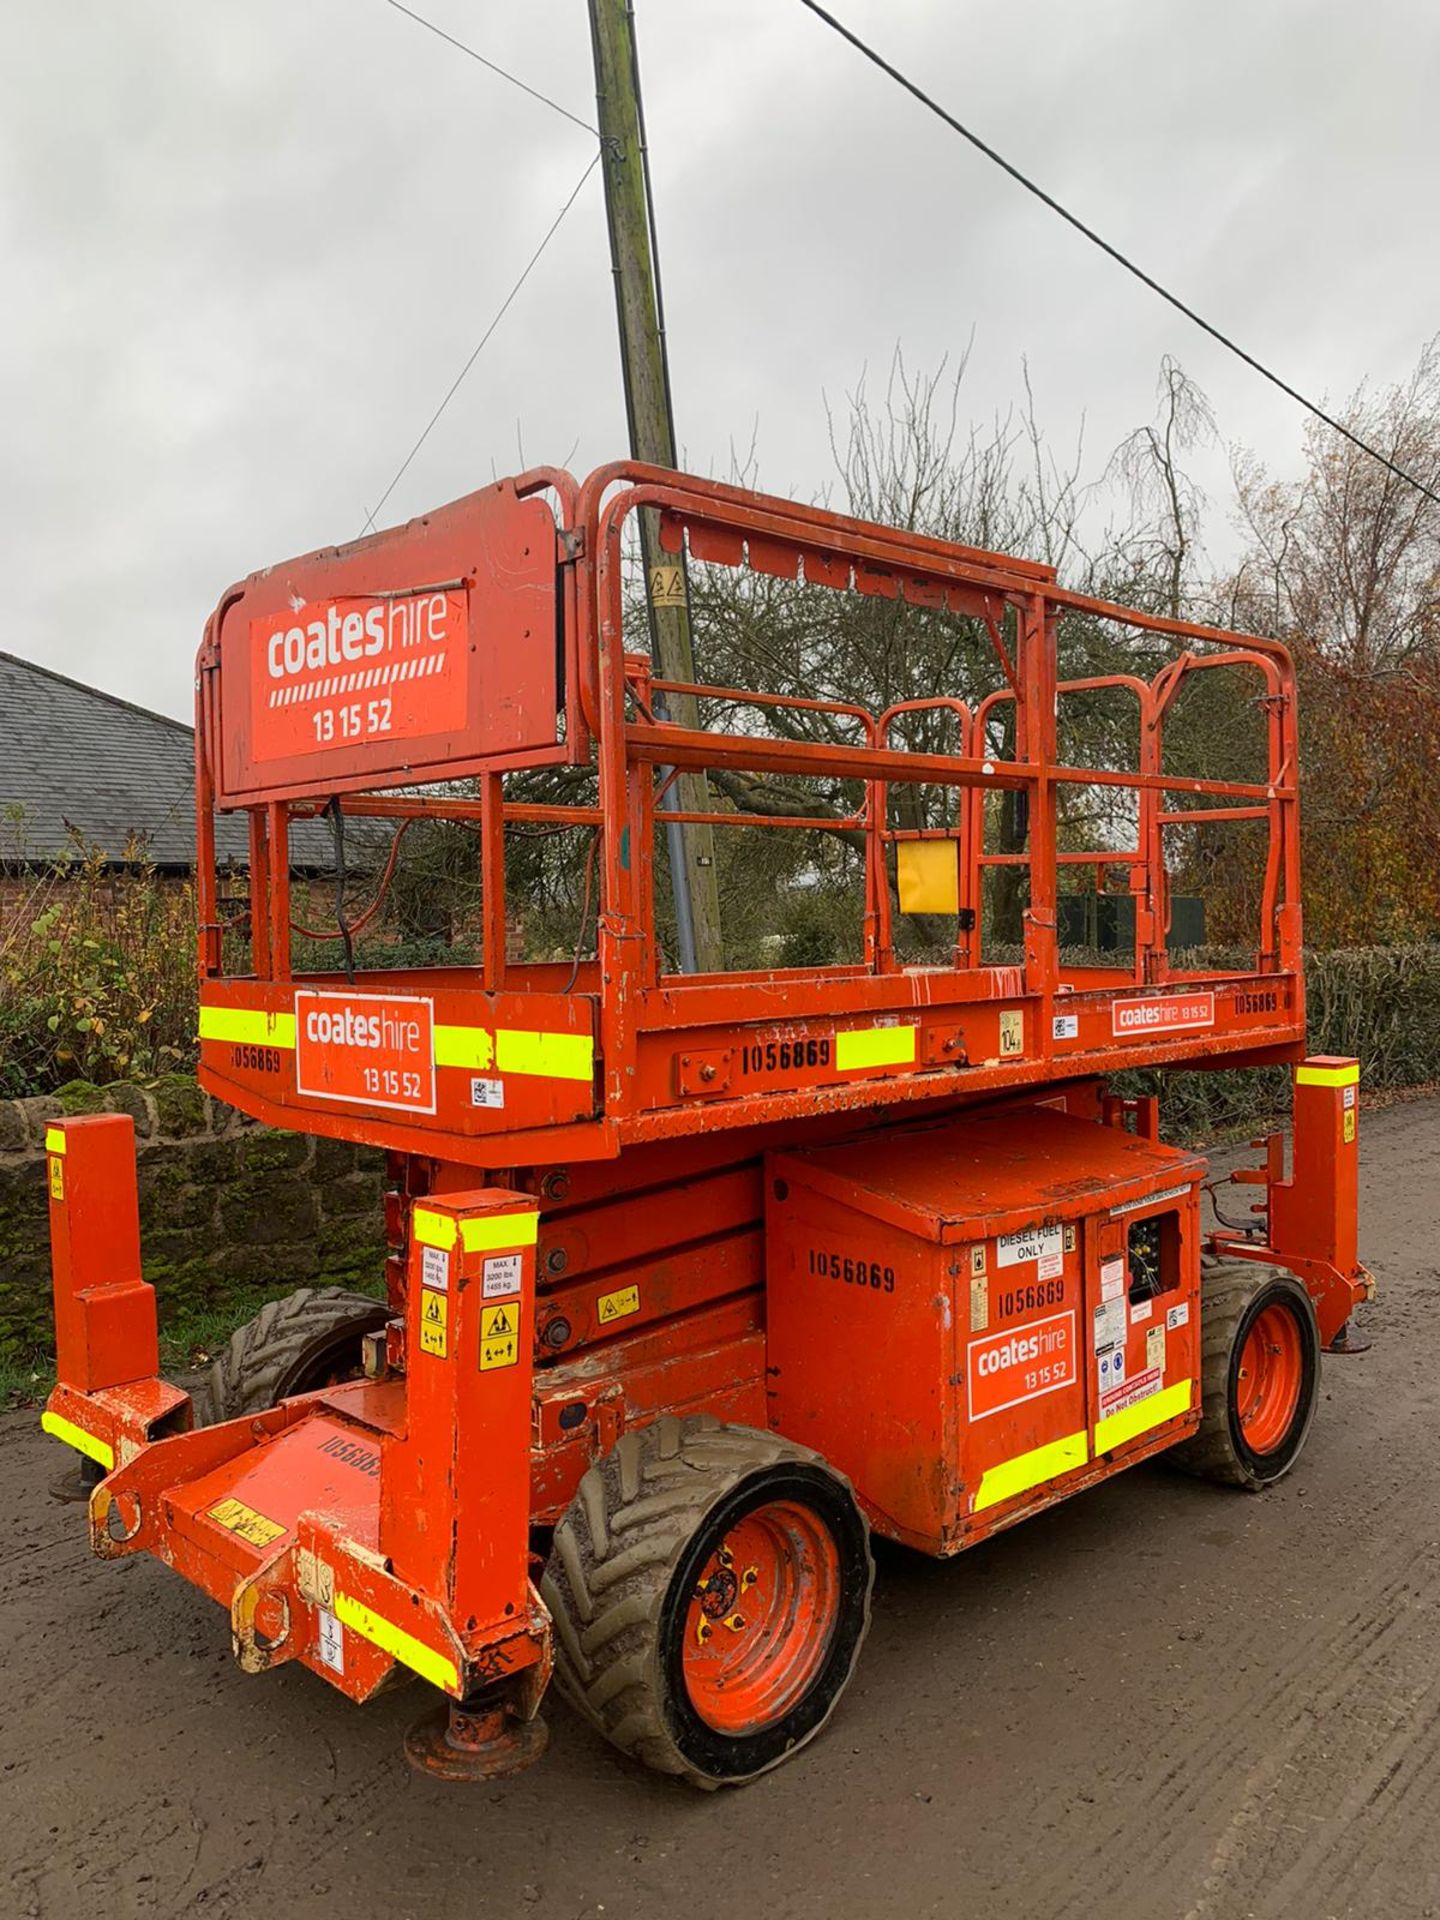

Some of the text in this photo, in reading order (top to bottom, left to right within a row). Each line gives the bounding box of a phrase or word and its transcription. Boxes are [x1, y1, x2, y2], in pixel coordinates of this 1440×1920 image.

[312, 698, 392, 743] 13 15 52
[1235, 992, 1277, 1015] 1056869
[741, 1039, 830, 1075] 1056869
[363, 1068, 421, 1098] 13 15 52
[1000, 1225, 1060, 1248] DIESEL FUEL
[1017, 1243, 1045, 1259] ONLY
[809, 1249, 895, 1293] 1056869
[999, 1280, 1064, 1319] 1056869
[1024, 1361, 1067, 1390] 13 15 52
